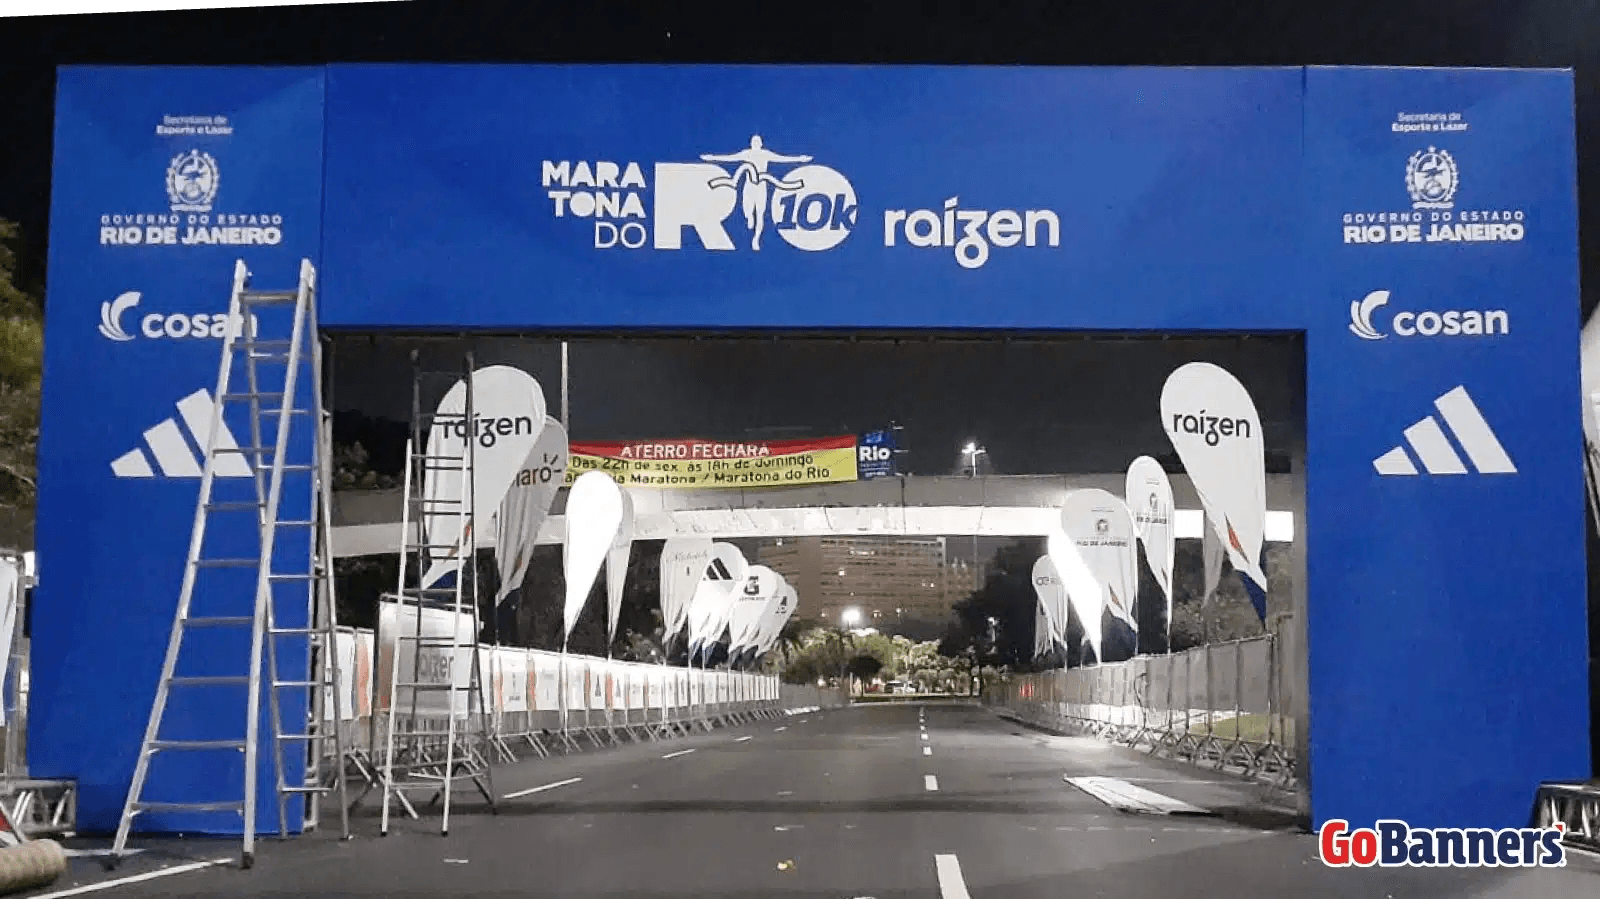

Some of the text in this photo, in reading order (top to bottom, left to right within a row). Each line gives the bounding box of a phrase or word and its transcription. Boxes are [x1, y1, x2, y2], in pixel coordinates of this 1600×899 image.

[214, 116, 228, 124] de
[1448, 112, 1461, 121] de
[156, 125, 233, 135] Esporte e Lazer
[1392, 122, 1469, 133] Esporte e Lazer
[542, 160, 646, 188] MARA
[548, 191, 646, 217] TONA
[101, 215, 282, 224] GOVERNO DO ESTADO
[1343, 211, 1524, 223] GOVERNO DO ESTADO
[100, 227, 281, 244] RIO DE JANEIRO
[594, 221, 647, 249] DO
[884, 196, 1060, 269] raízen
[1343, 223, 1524, 243] RIO DE JANEIRO
[1393, 309, 1509, 336] cosan
[1173, 409, 1251, 447] raízen
[621, 444, 687, 458] ATERRO
[859, 445, 891, 461] Rio
[572, 456, 597, 469] Das
[603, 458, 629, 470] 22h
[634, 461, 650, 470] de
[708, 459, 729, 471] 18h
[734, 459, 750, 469] de
[630, 473, 696, 484] Maratona
[714, 472, 779, 483] Maratona
[785, 469, 802, 480] do
[807, 467, 830, 478] Rio
